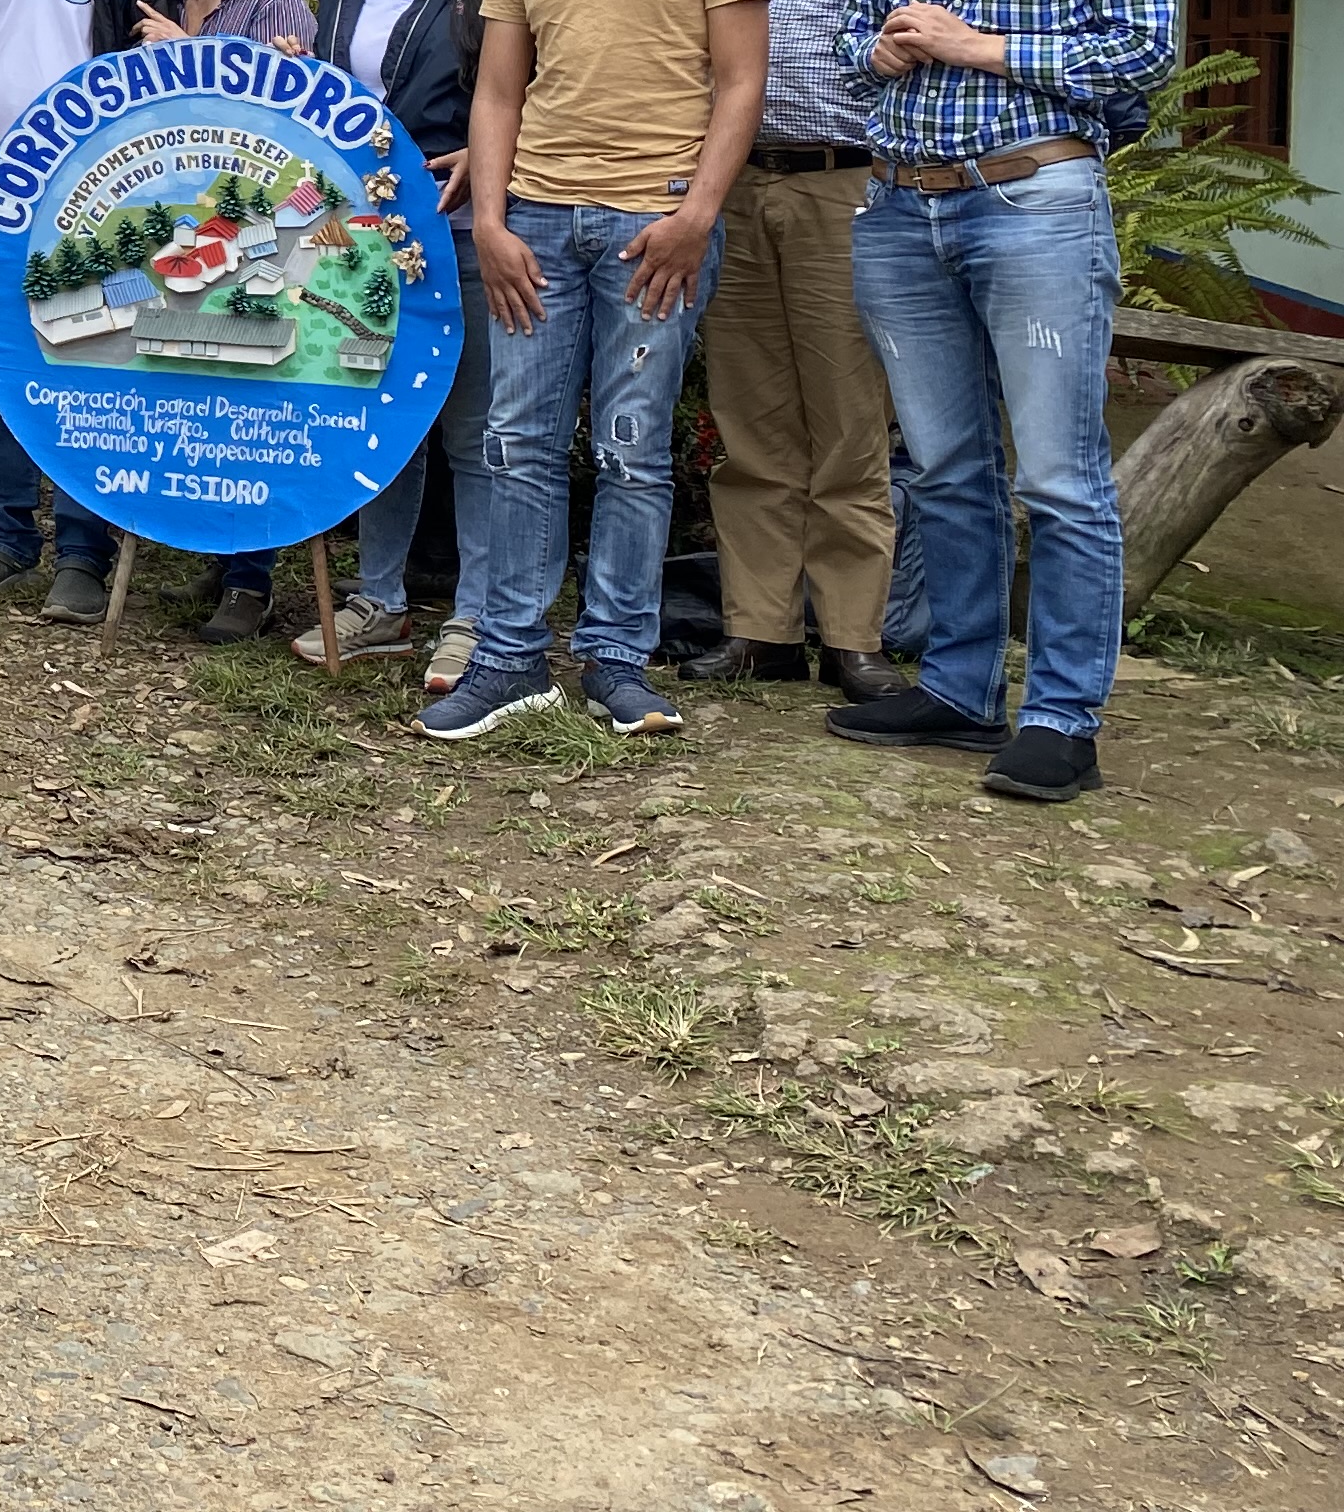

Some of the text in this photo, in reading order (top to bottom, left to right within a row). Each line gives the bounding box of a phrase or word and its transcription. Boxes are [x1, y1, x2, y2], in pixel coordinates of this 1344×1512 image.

[56, 129, 290, 231] COMPROMETIDOS CON EL SER
[78, 153, 277, 238] Y EL MEDIO AMBIENTE
[25, 381, 147, 412] Corporación
[215, 395, 303, 423] Desarrollo
[308, 403, 367, 432] Social
[56, 404, 136, 434] Ambiental,
[230, 419, 313, 448] Cultural,
[151, 441, 164, 462] y
[173, 435, 295, 468] Agropecuario
[299, 447, 322, 467] de
[95, 465, 270, 506] SAN ISIDRO
